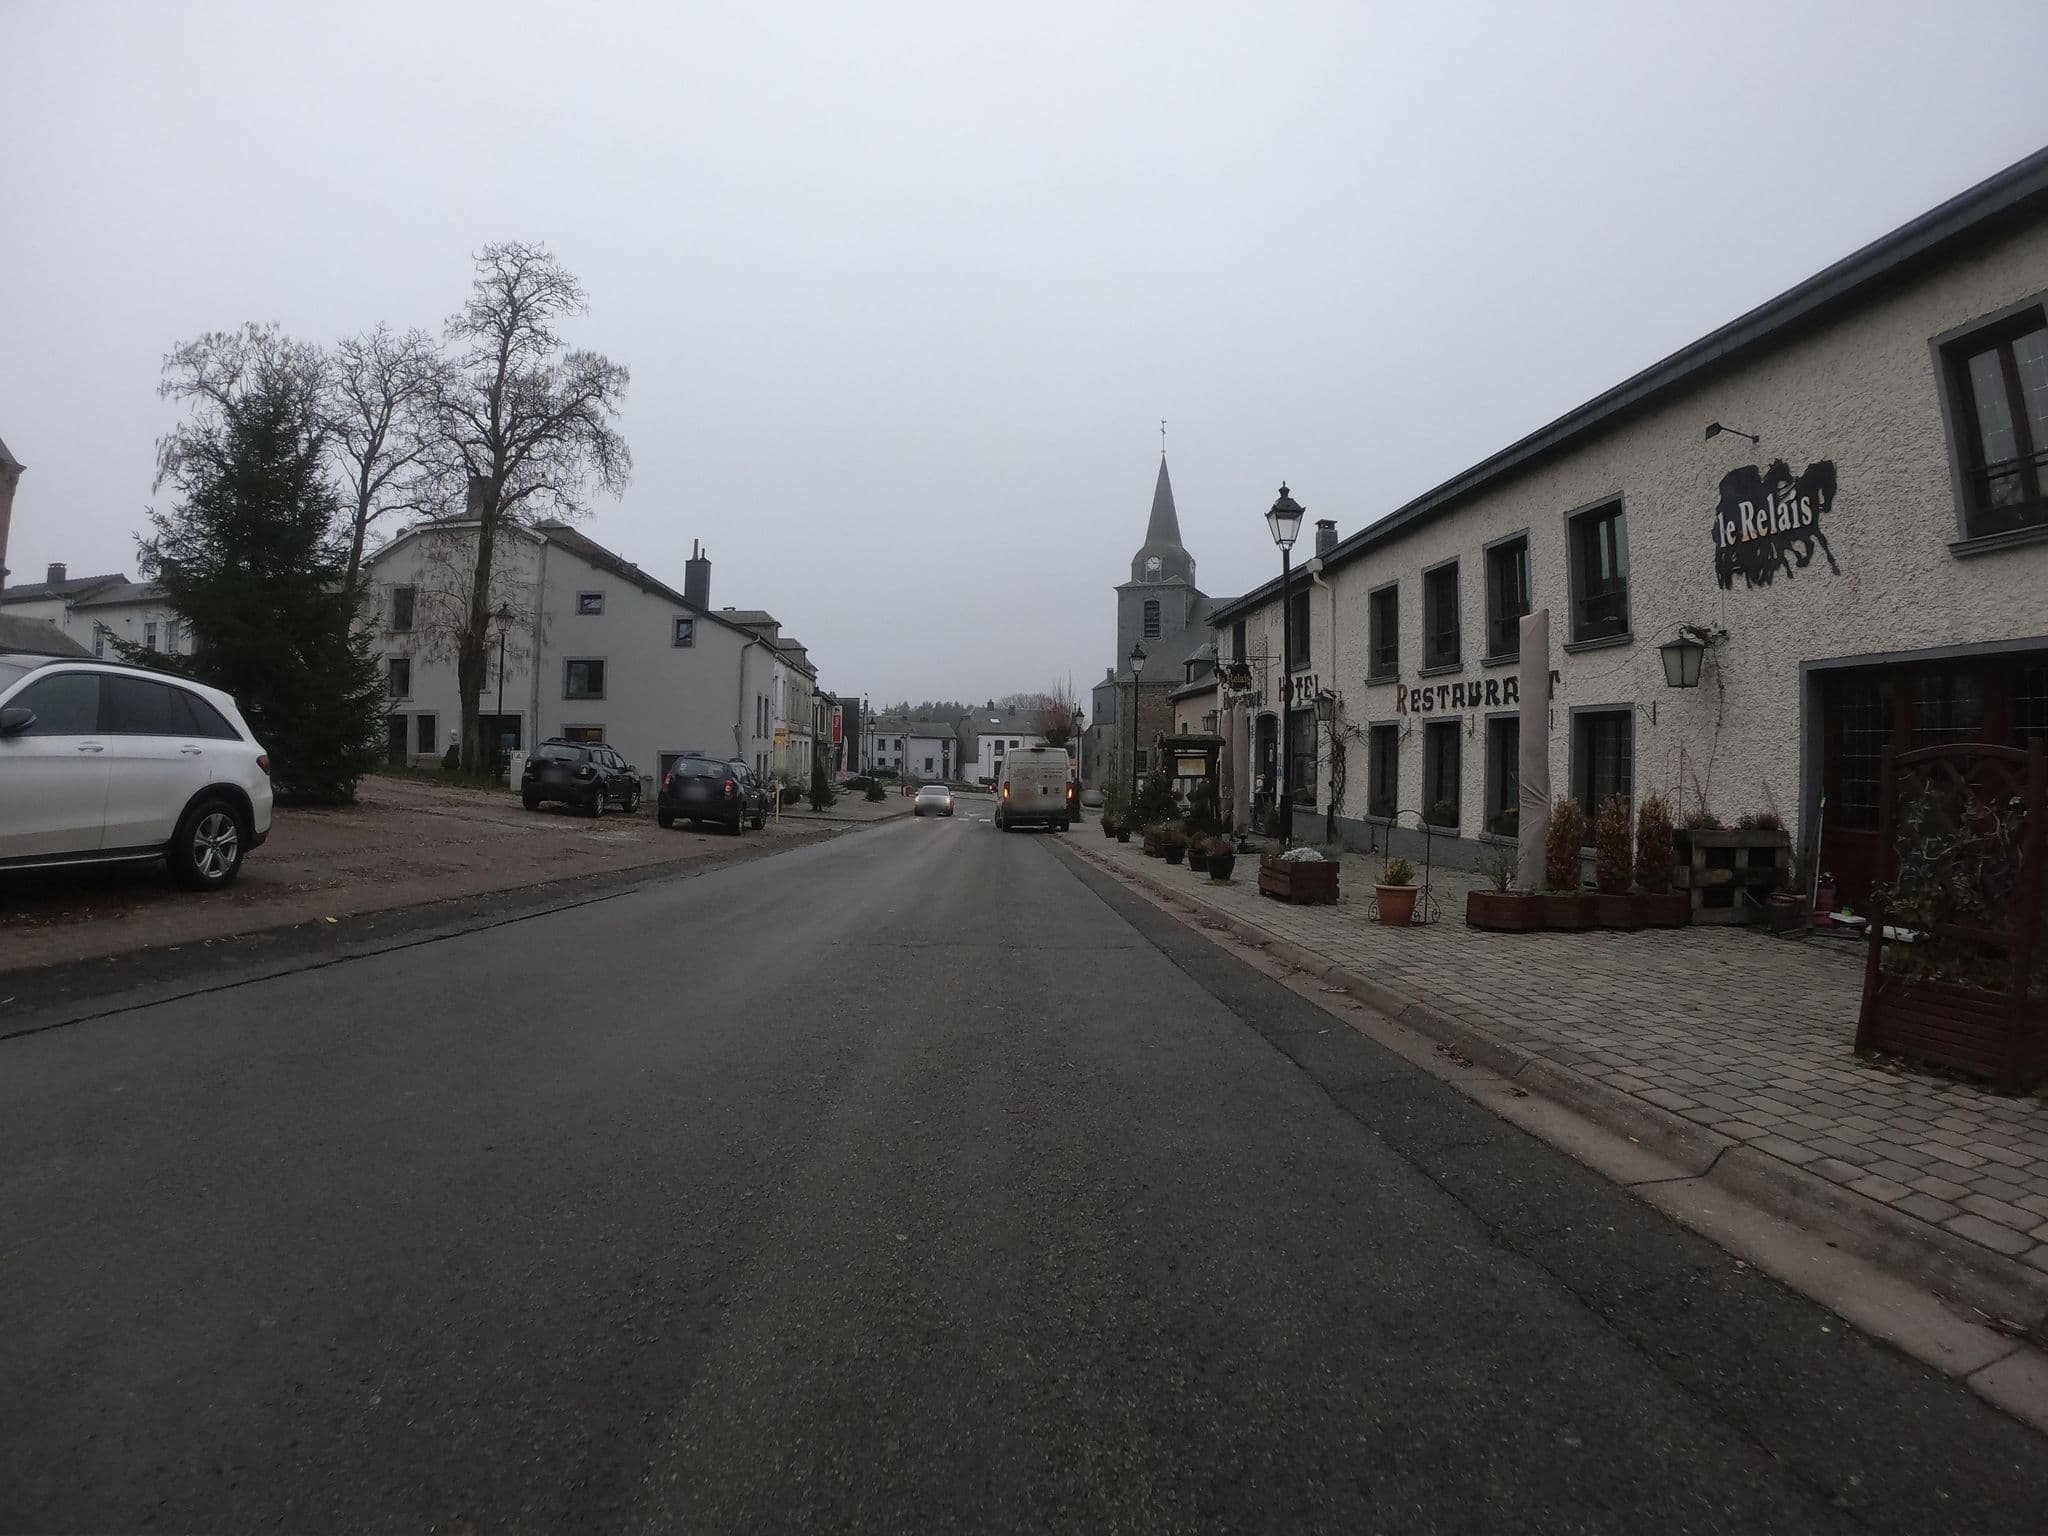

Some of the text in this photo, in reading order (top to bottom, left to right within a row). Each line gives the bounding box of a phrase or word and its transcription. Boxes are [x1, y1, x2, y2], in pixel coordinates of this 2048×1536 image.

[1717, 492, 1813, 548] le Relais
[1396, 669, 1561, 716] RESTAURAT
